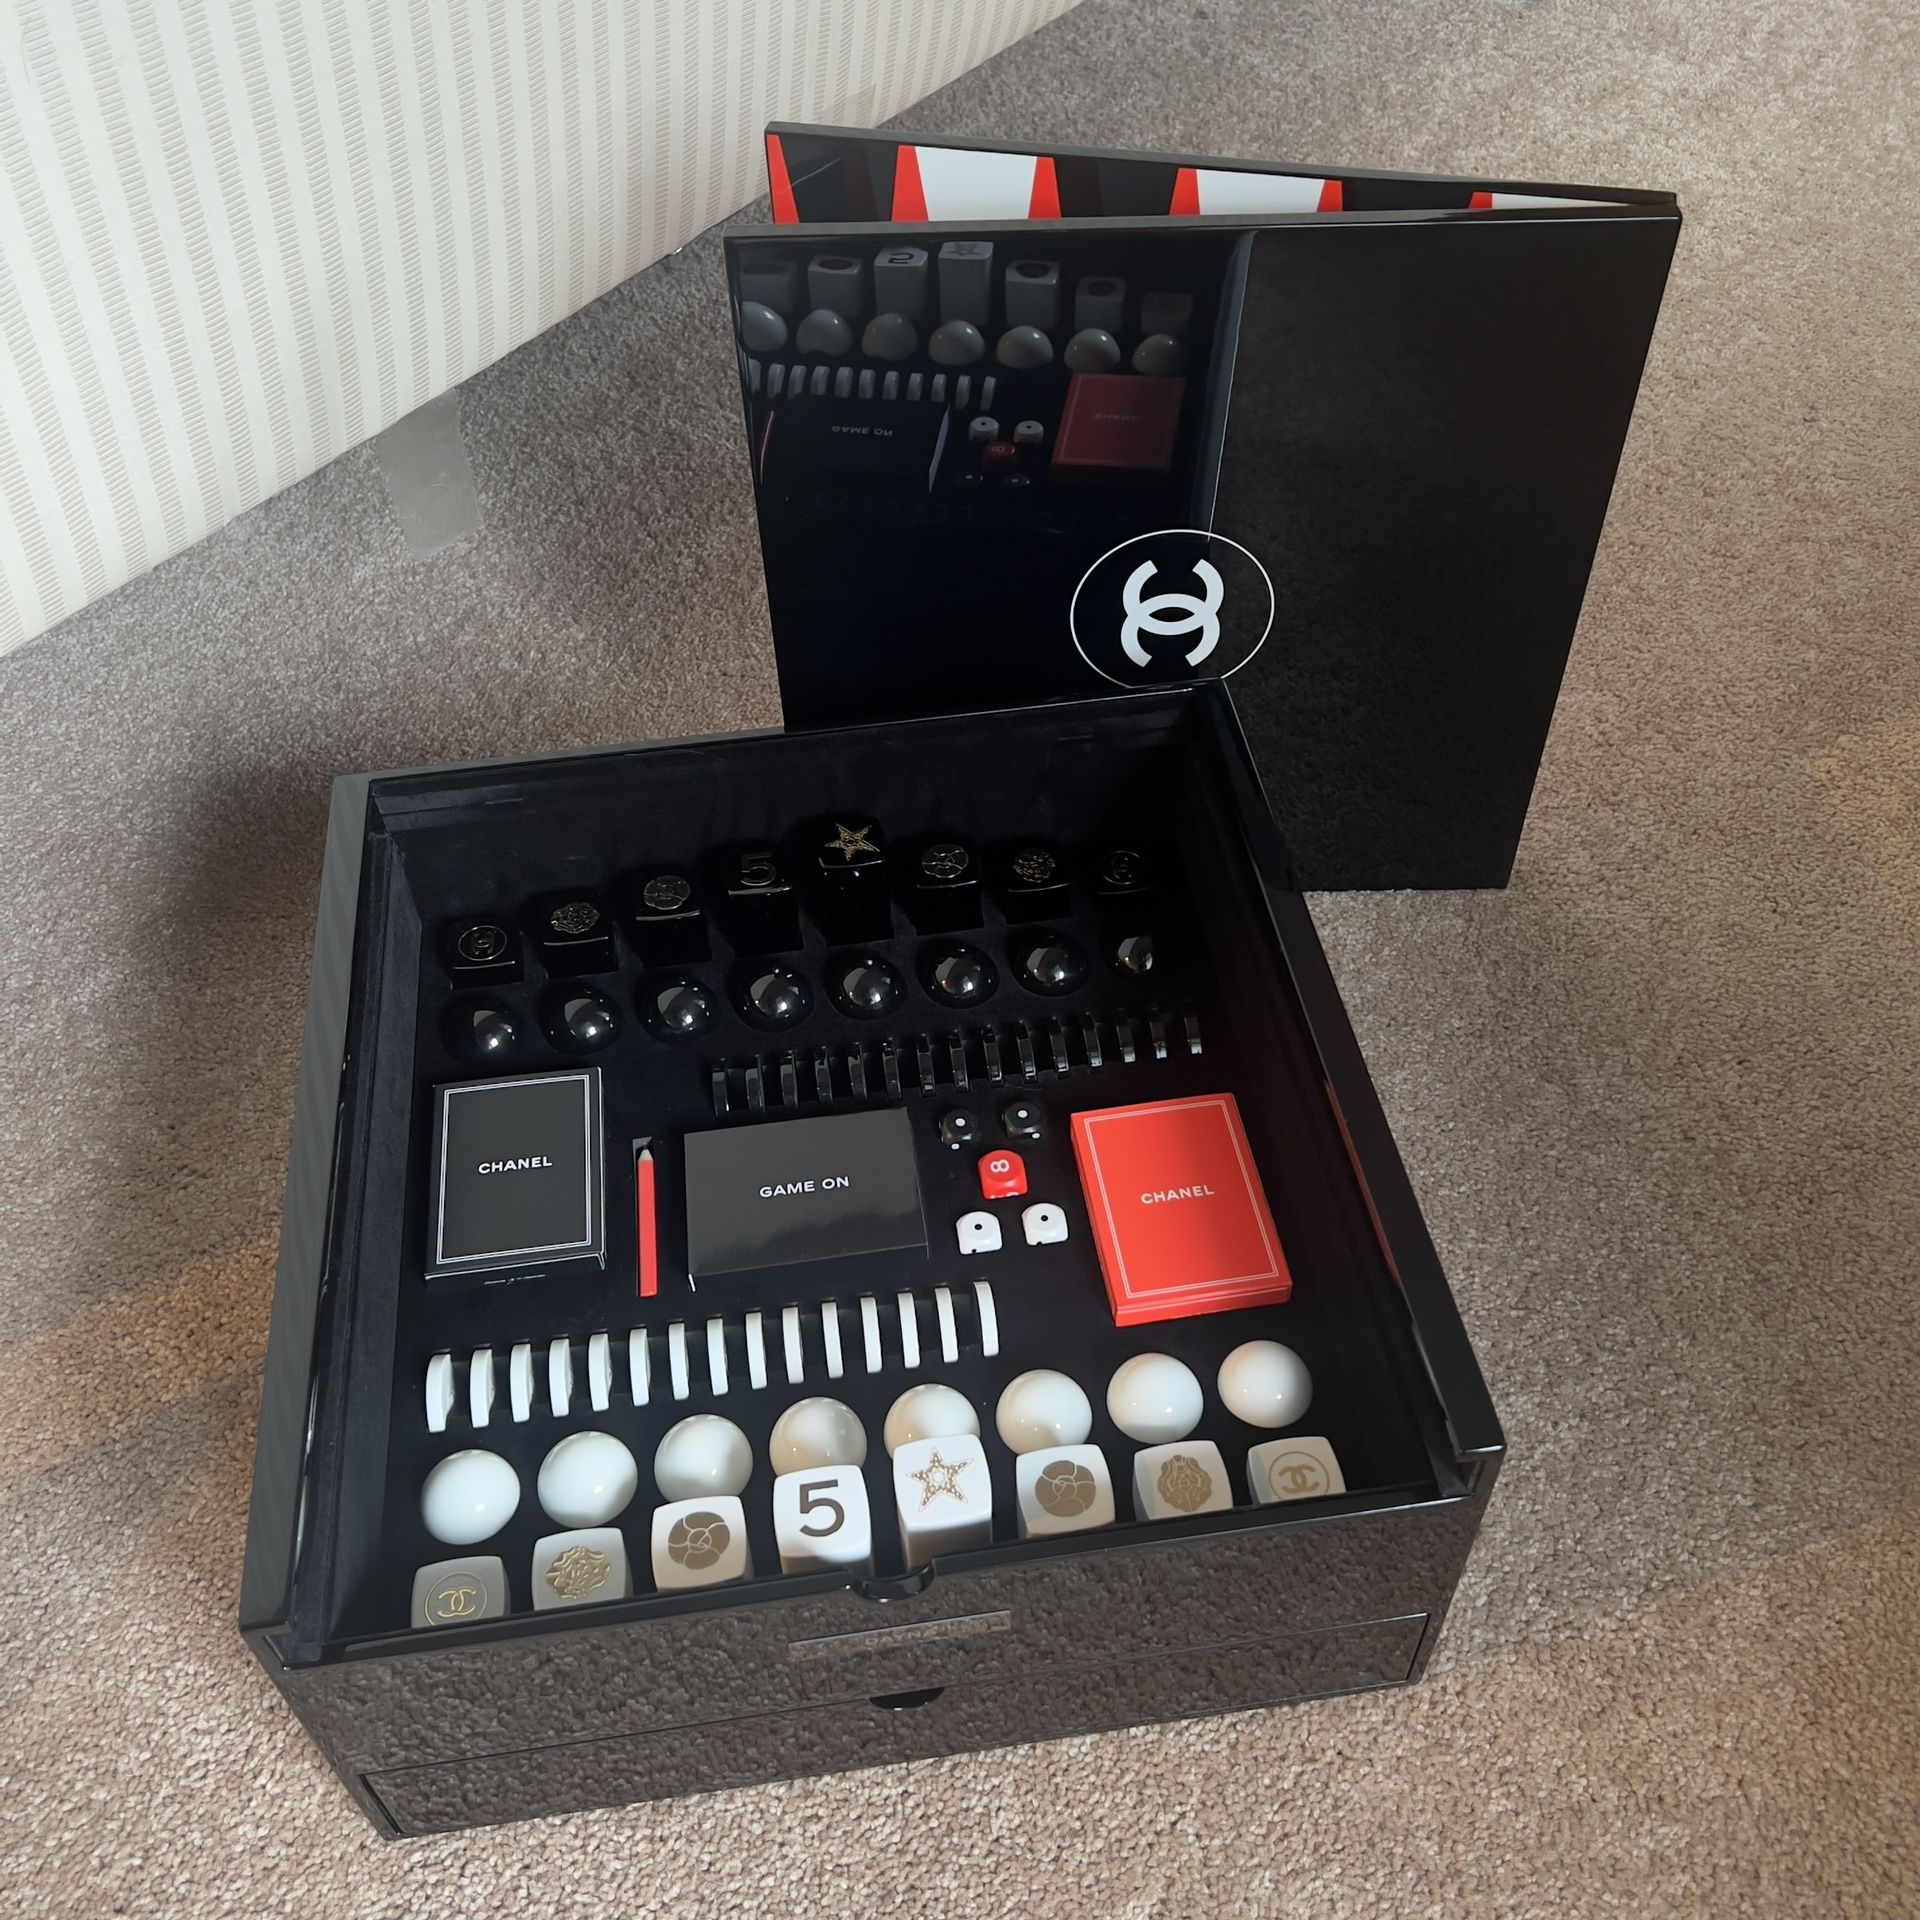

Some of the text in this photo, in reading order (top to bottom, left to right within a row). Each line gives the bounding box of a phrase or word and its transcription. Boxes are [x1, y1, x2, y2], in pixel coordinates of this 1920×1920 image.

[478, 1156, 553, 1174] CHANEL
[759, 1176, 850, 1198] GAME ON
[1140, 1184, 1215, 1205] CHANEL
[799, 1479, 845, 1537] 5
